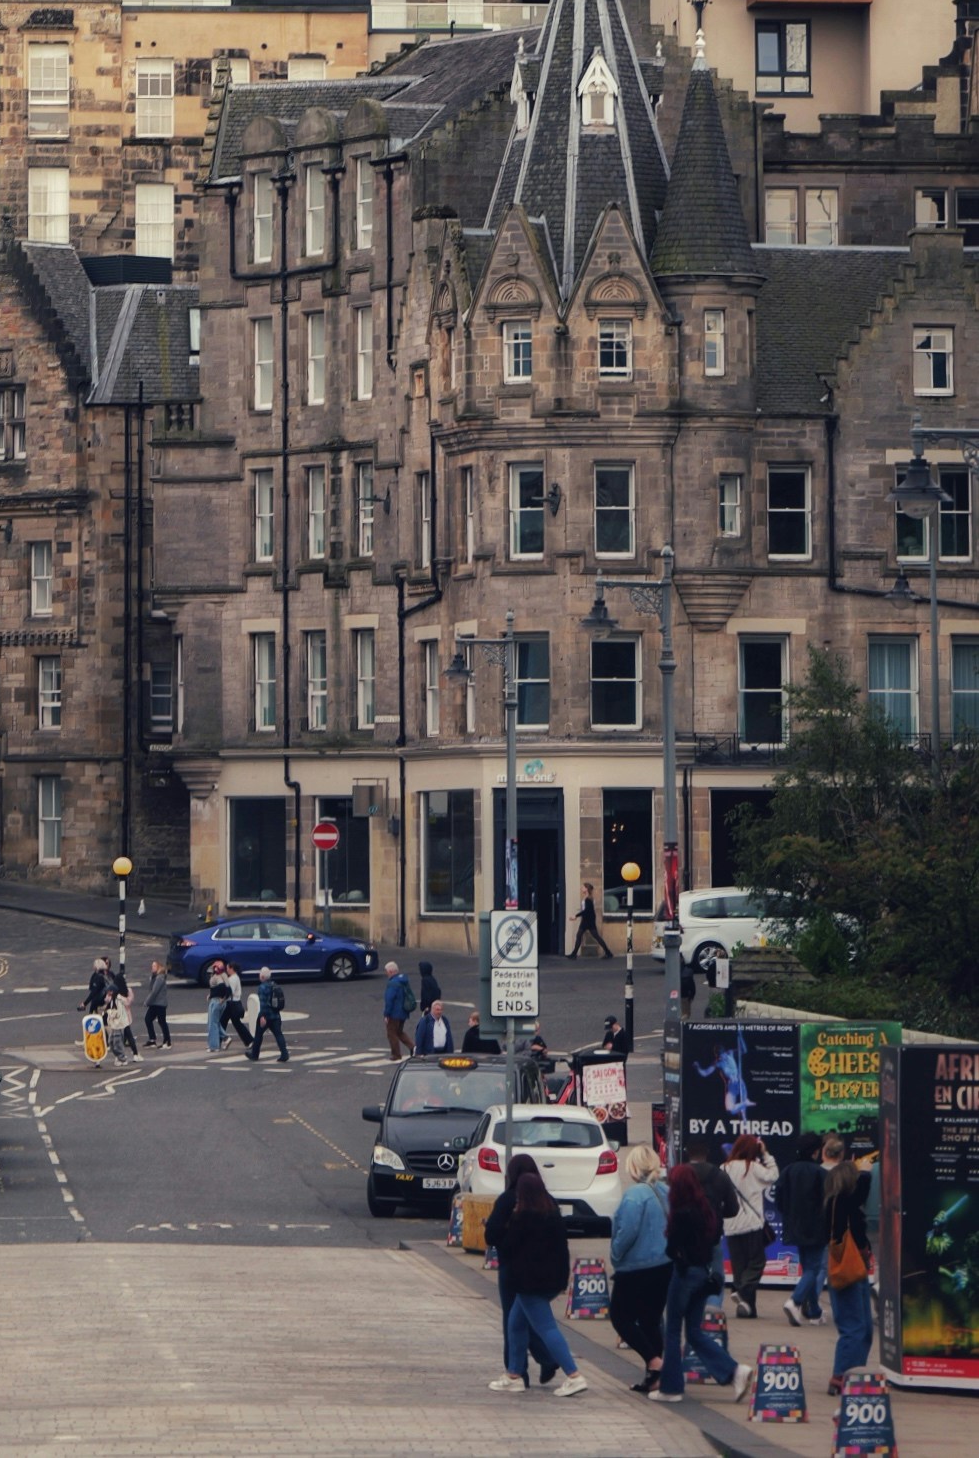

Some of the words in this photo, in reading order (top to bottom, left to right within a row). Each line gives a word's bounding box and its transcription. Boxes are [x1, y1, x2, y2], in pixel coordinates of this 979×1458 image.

[494, 970, 535, 979] Pedestrian
[496, 980, 511, 988] and
[512, 980, 532, 989] cycle
[505, 990, 524, 998] Zone
[497, 1001, 532, 1012] ENDS
[746, 1024, 768, 1032] METRES
[817, 1031, 874, 1049] Catching
[879, 1031, 889, 1046] A
[806, 1046, 880, 1077] CHEES
[934, 1086, 952, 1103] EN
[689, 1119, 710, 1134] BY
[713, 1120, 726, 1134] A
[729, 1120, 793, 1136] THREAD
[941, 1134, 970, 1142] SHOW
[395, 1173, 415, 1181] TAXI
[578, 1279, 606, 1295] 900
[763, 1371, 800, 1392] 900
[845, 1403, 886, 1426] 900
